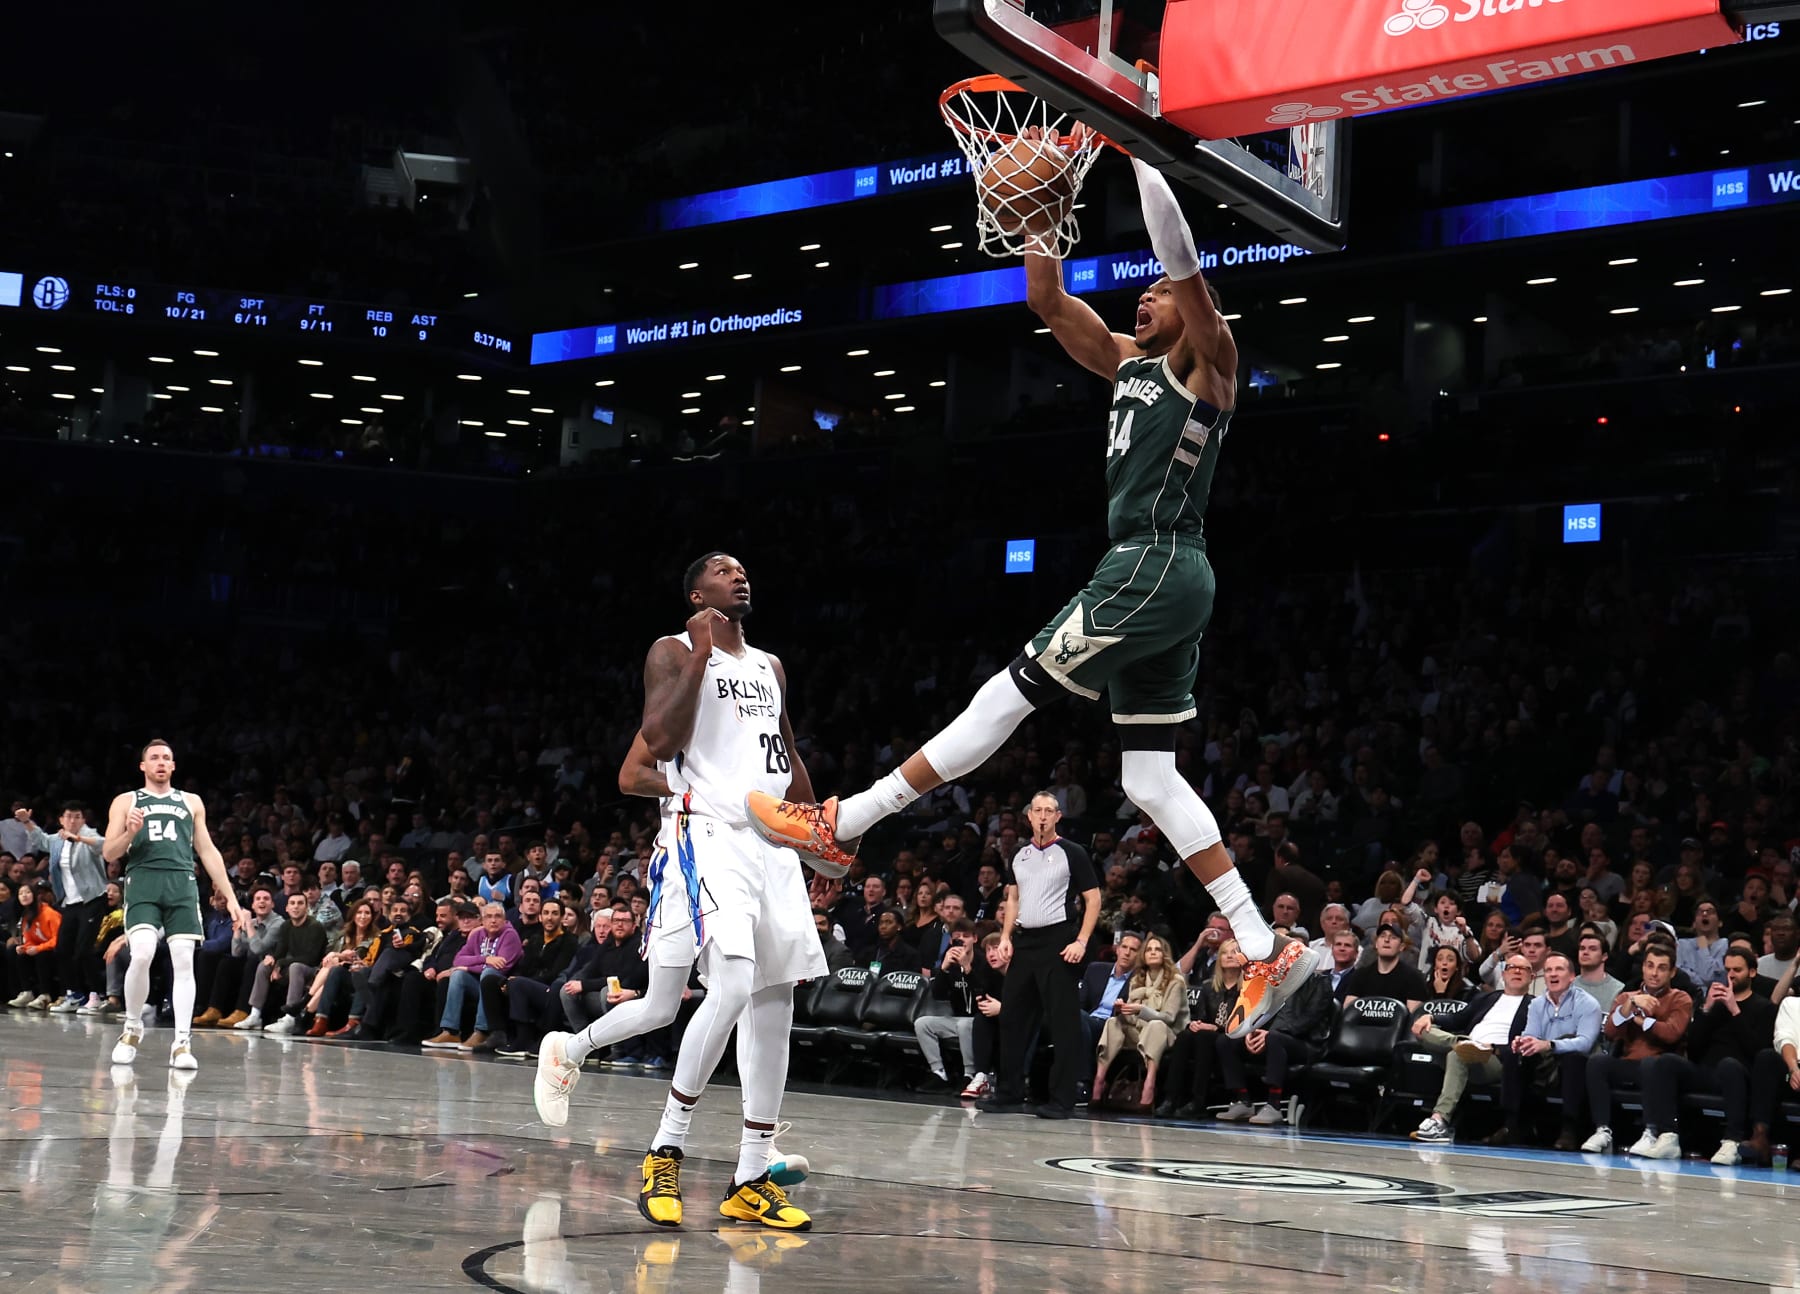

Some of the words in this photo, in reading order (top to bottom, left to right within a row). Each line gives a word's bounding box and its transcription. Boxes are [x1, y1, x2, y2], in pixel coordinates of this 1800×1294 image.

[889, 162, 937, 185] World
[940, 158, 962, 177] #1
[856, 176, 875, 188] HSS
[1716, 181, 1744, 197] HSS
[1199, 250, 1218, 270] in
[1223, 243, 1312, 264] Orthope
[1074, 269, 1095, 282] HSS
[96, 284, 125, 298] FLS:
[127, 288, 137, 299] 0
[177, 292, 196, 304] FG
[94, 299, 124, 312] TOL:
[125, 303, 135, 315] 6
[240, 298, 265, 310] 3PT
[308, 304, 326, 316] FT
[366, 310, 394, 322] REB
[411, 314, 438, 326] AST
[372, 325, 388, 338] 10
[626, 324, 667, 345] World
[670, 321, 689, 339] #1
[692, 319, 706, 336] in
[709, 308, 803, 332] Orthopedics
[418, 330, 428, 341] 9
[473, 331, 495, 347] 8:17
[495, 338, 512, 353] PM
[597, 334, 614, 346] HSS
[1106, 409, 1135, 458] 34
[1567, 516, 1597, 531] HSS
[1009, 550, 1031, 562] HSS
[716, 677, 775, 706] BKLYN
[738, 704, 775, 719] NETS
[759, 732, 792, 775] 28
[148, 819, 178, 841] 24
[838, 969, 869, 981] QATAR
[887, 972, 921, 984] QATAR
[1354, 999, 1397, 1012] QATAR
[1361, 1010, 1394, 1018] AIRWAYS
